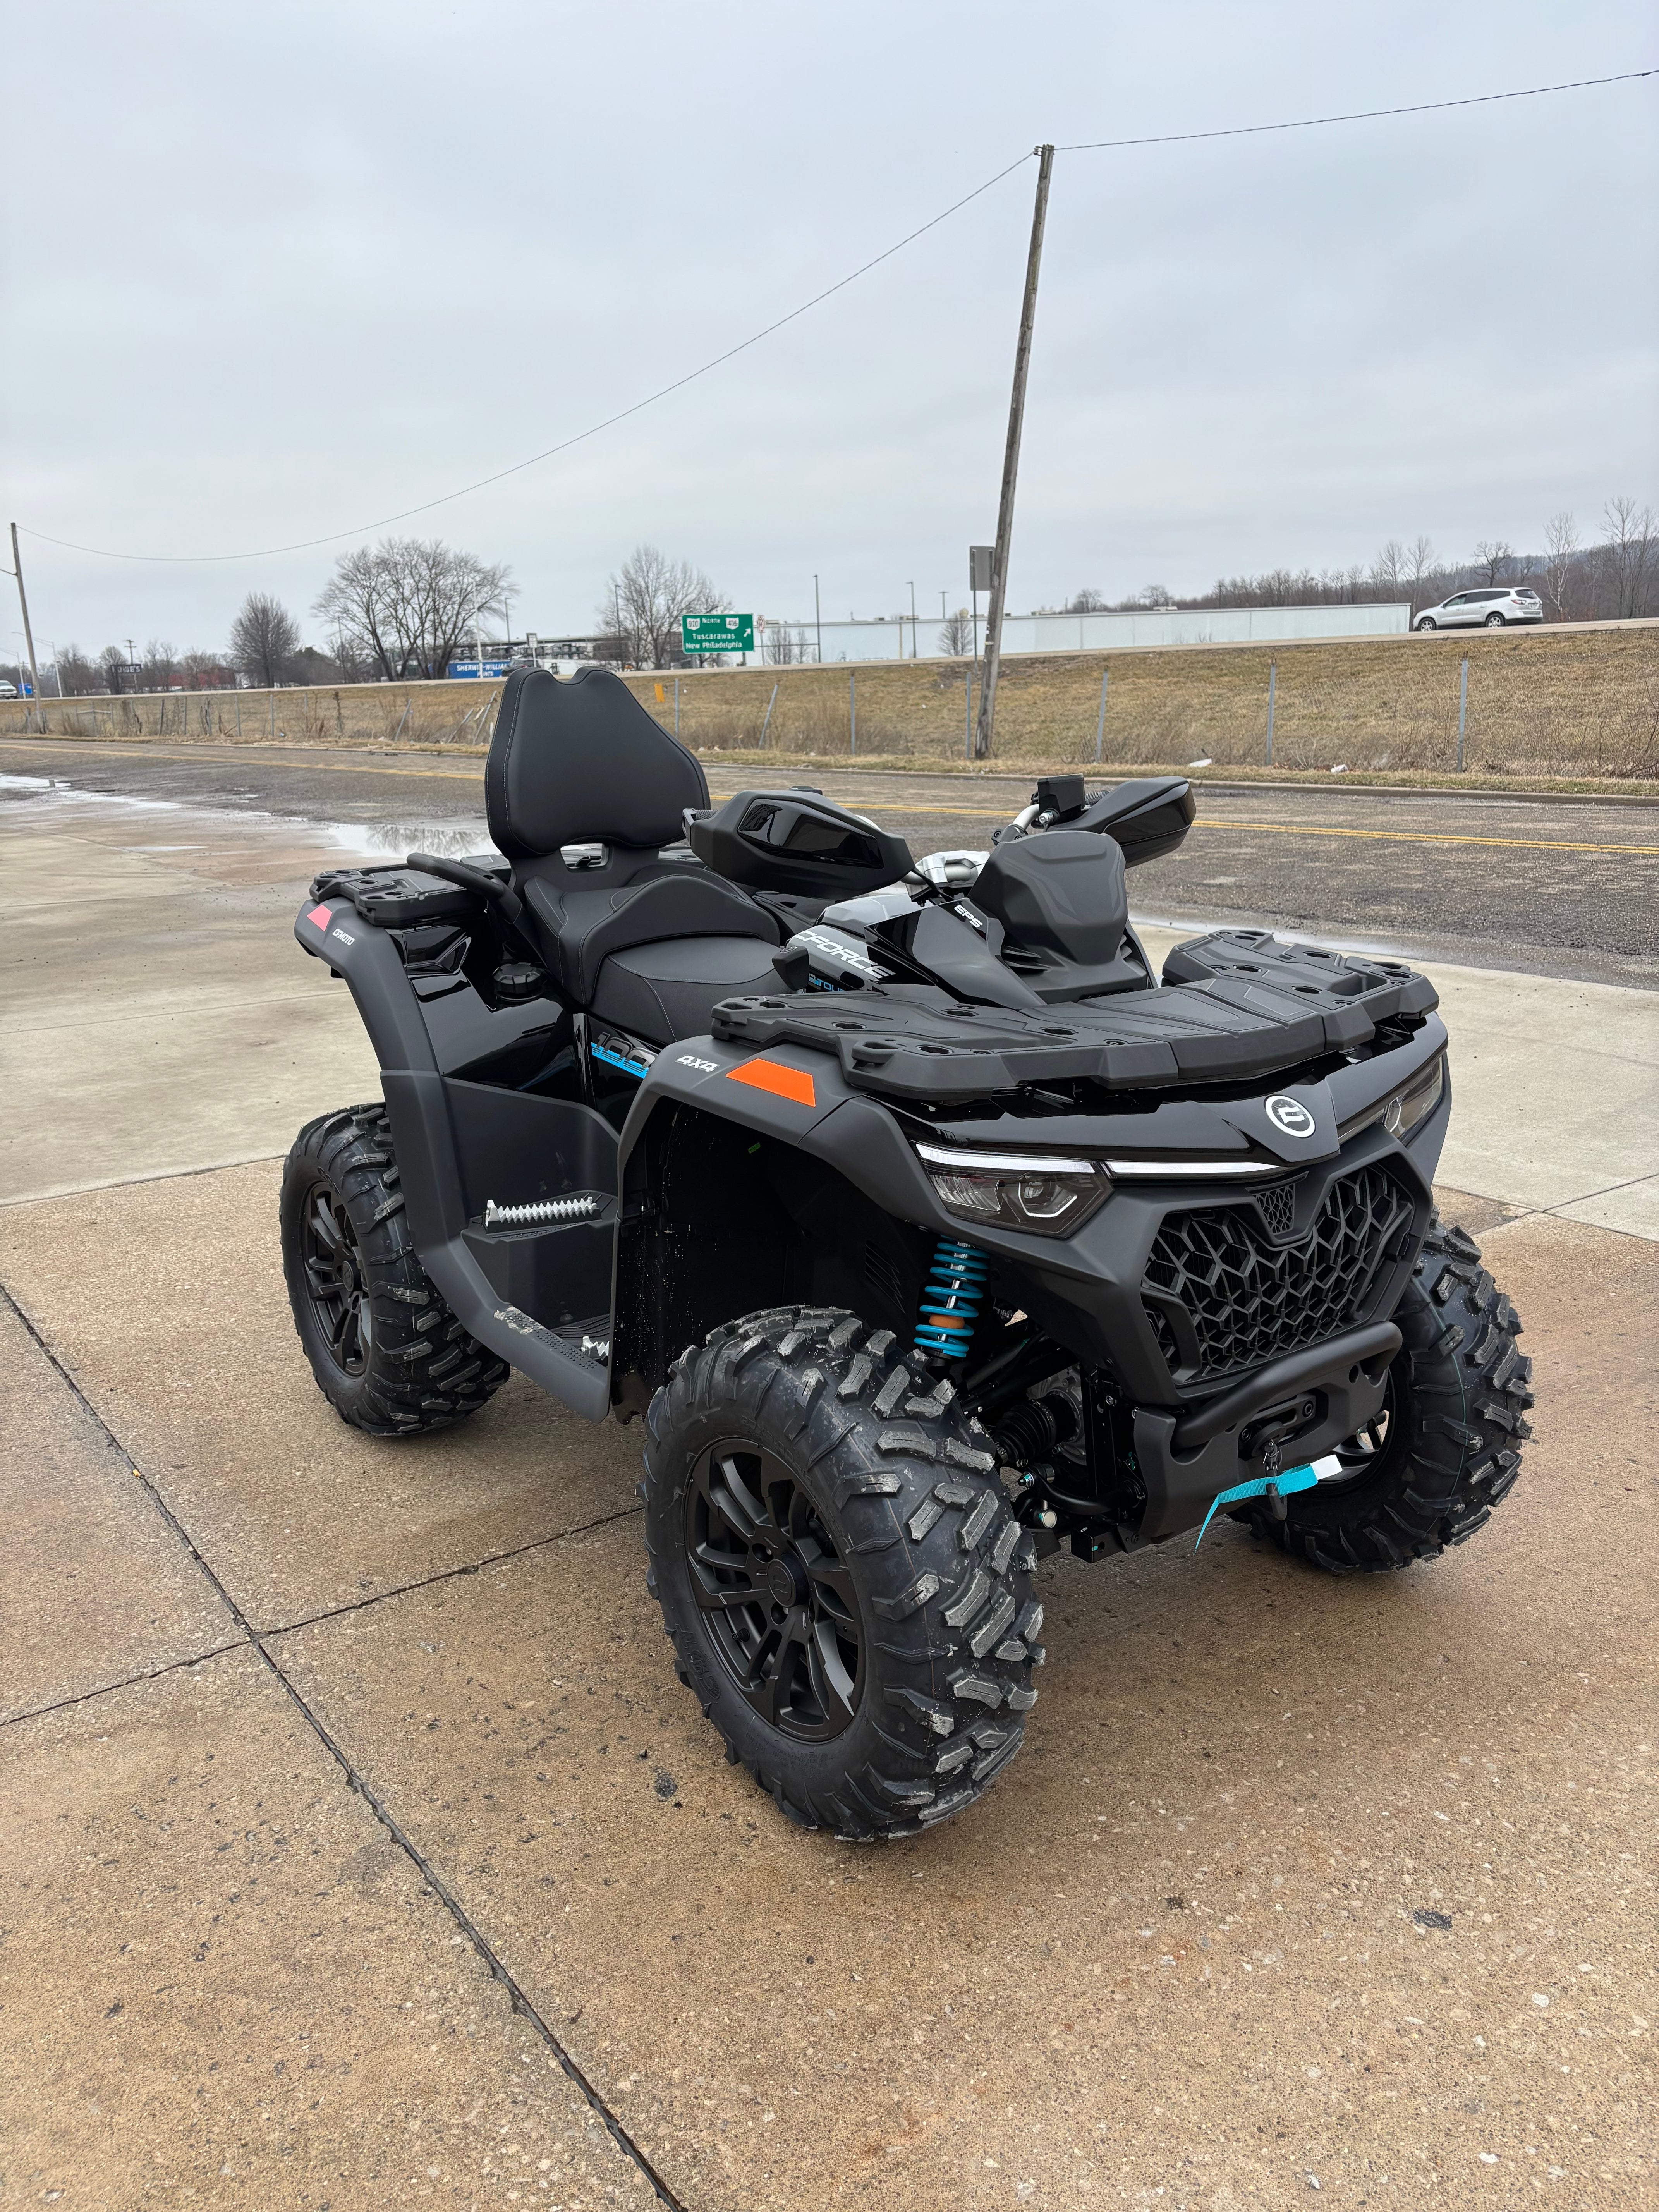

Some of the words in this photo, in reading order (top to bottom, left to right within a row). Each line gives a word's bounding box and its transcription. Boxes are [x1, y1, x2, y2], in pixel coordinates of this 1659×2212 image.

[954, 905, 983, 928] EPS
[332, 928, 355, 946] CFMOTO
[793, 930, 896, 979] CFORCE
